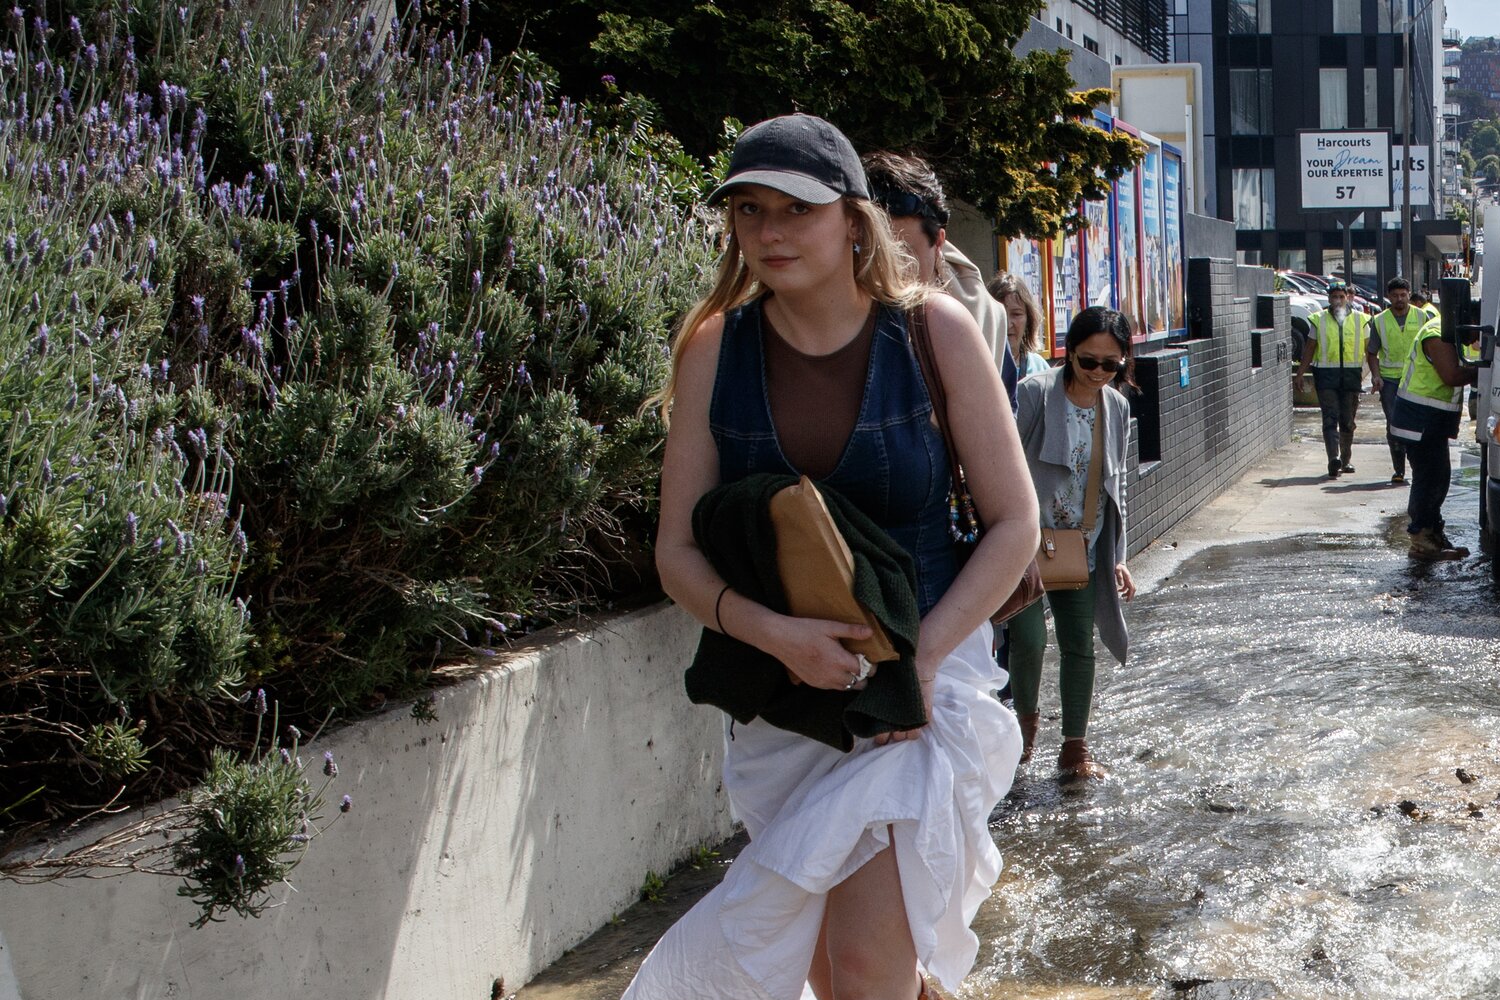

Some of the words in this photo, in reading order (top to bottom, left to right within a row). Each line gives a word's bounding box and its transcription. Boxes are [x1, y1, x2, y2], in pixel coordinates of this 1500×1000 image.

[1317, 137, 1371, 147] Harcourts
[1306, 159, 1334, 168] YOUR
[1333, 149, 1382, 171] Dream
[1307, 169, 1329, 178] OUR
[1331, 168, 1384, 178] EXPERTISE
[1335, 186, 1356, 199] 57
